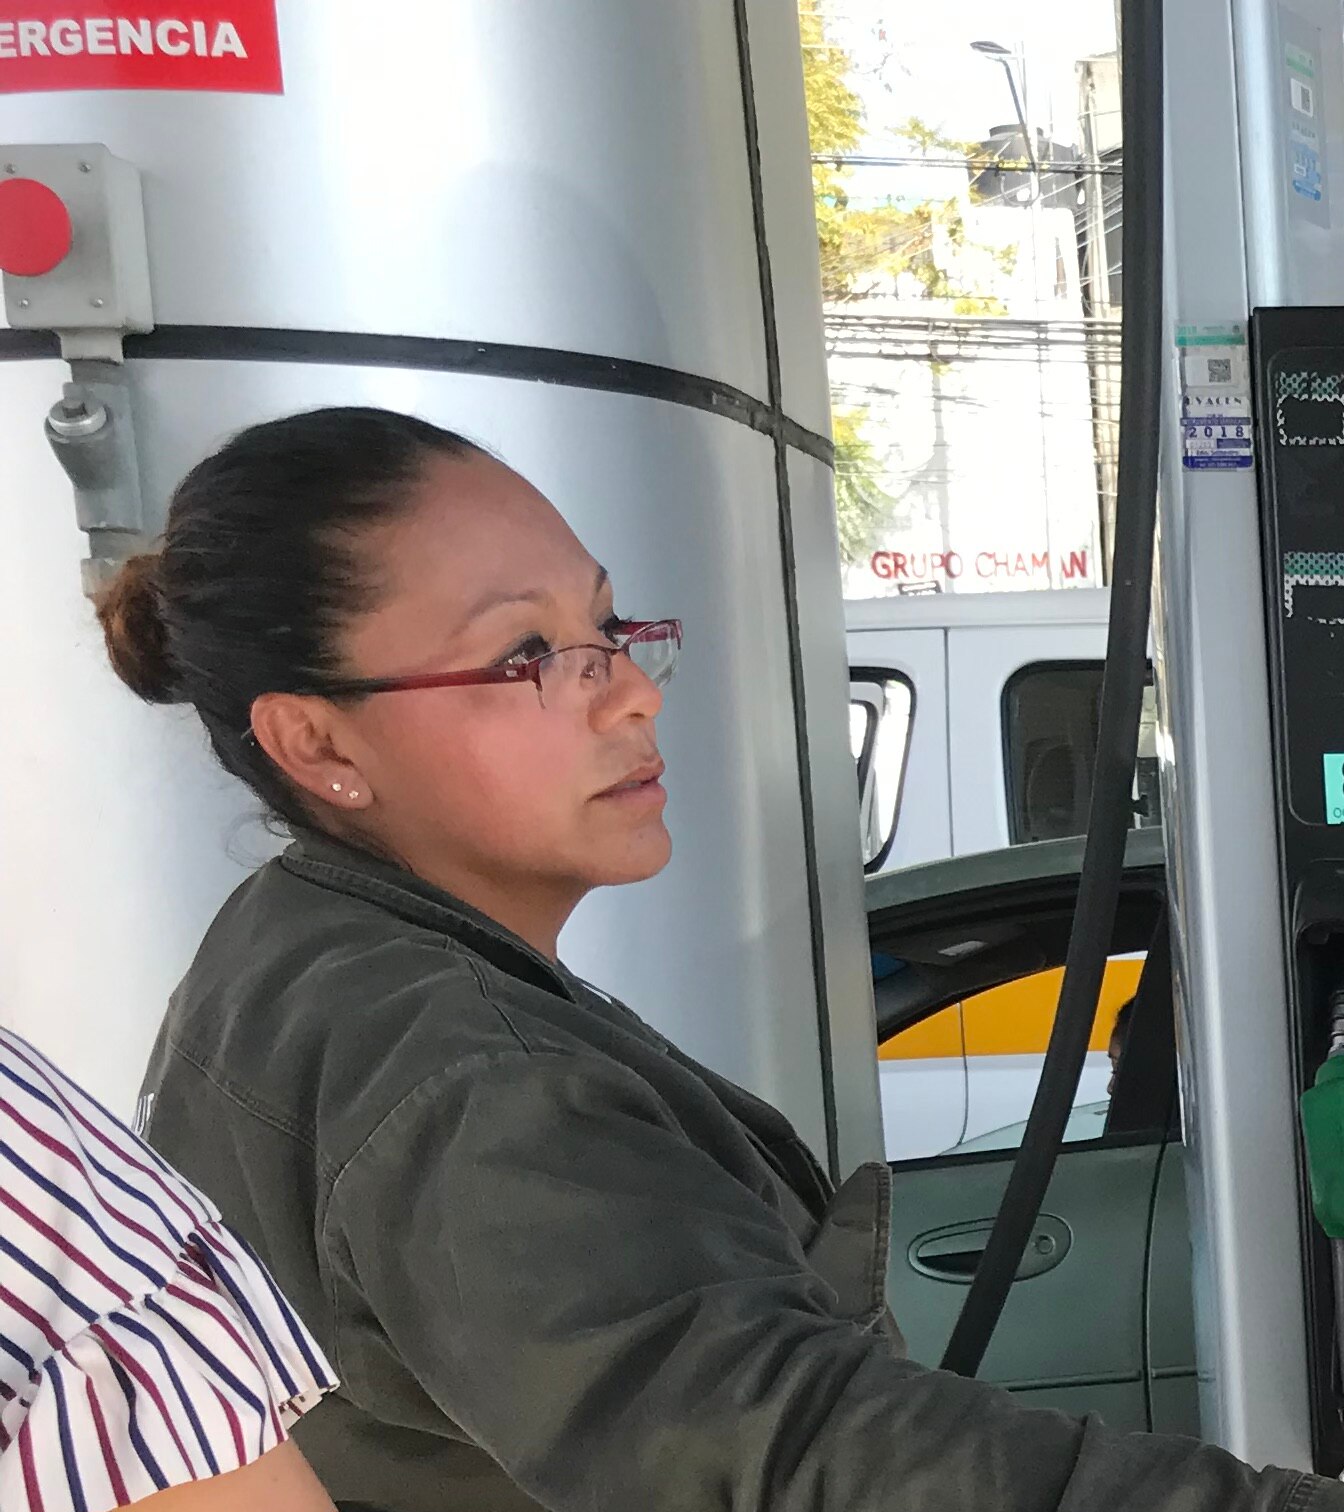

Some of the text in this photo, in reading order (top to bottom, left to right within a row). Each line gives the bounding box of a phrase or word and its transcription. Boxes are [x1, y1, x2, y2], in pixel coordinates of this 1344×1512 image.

[0, 18, 249, 58] ERGENCIA
[1188, 426, 1244, 438] 2018
[871, 551, 964, 580] GRUPO
